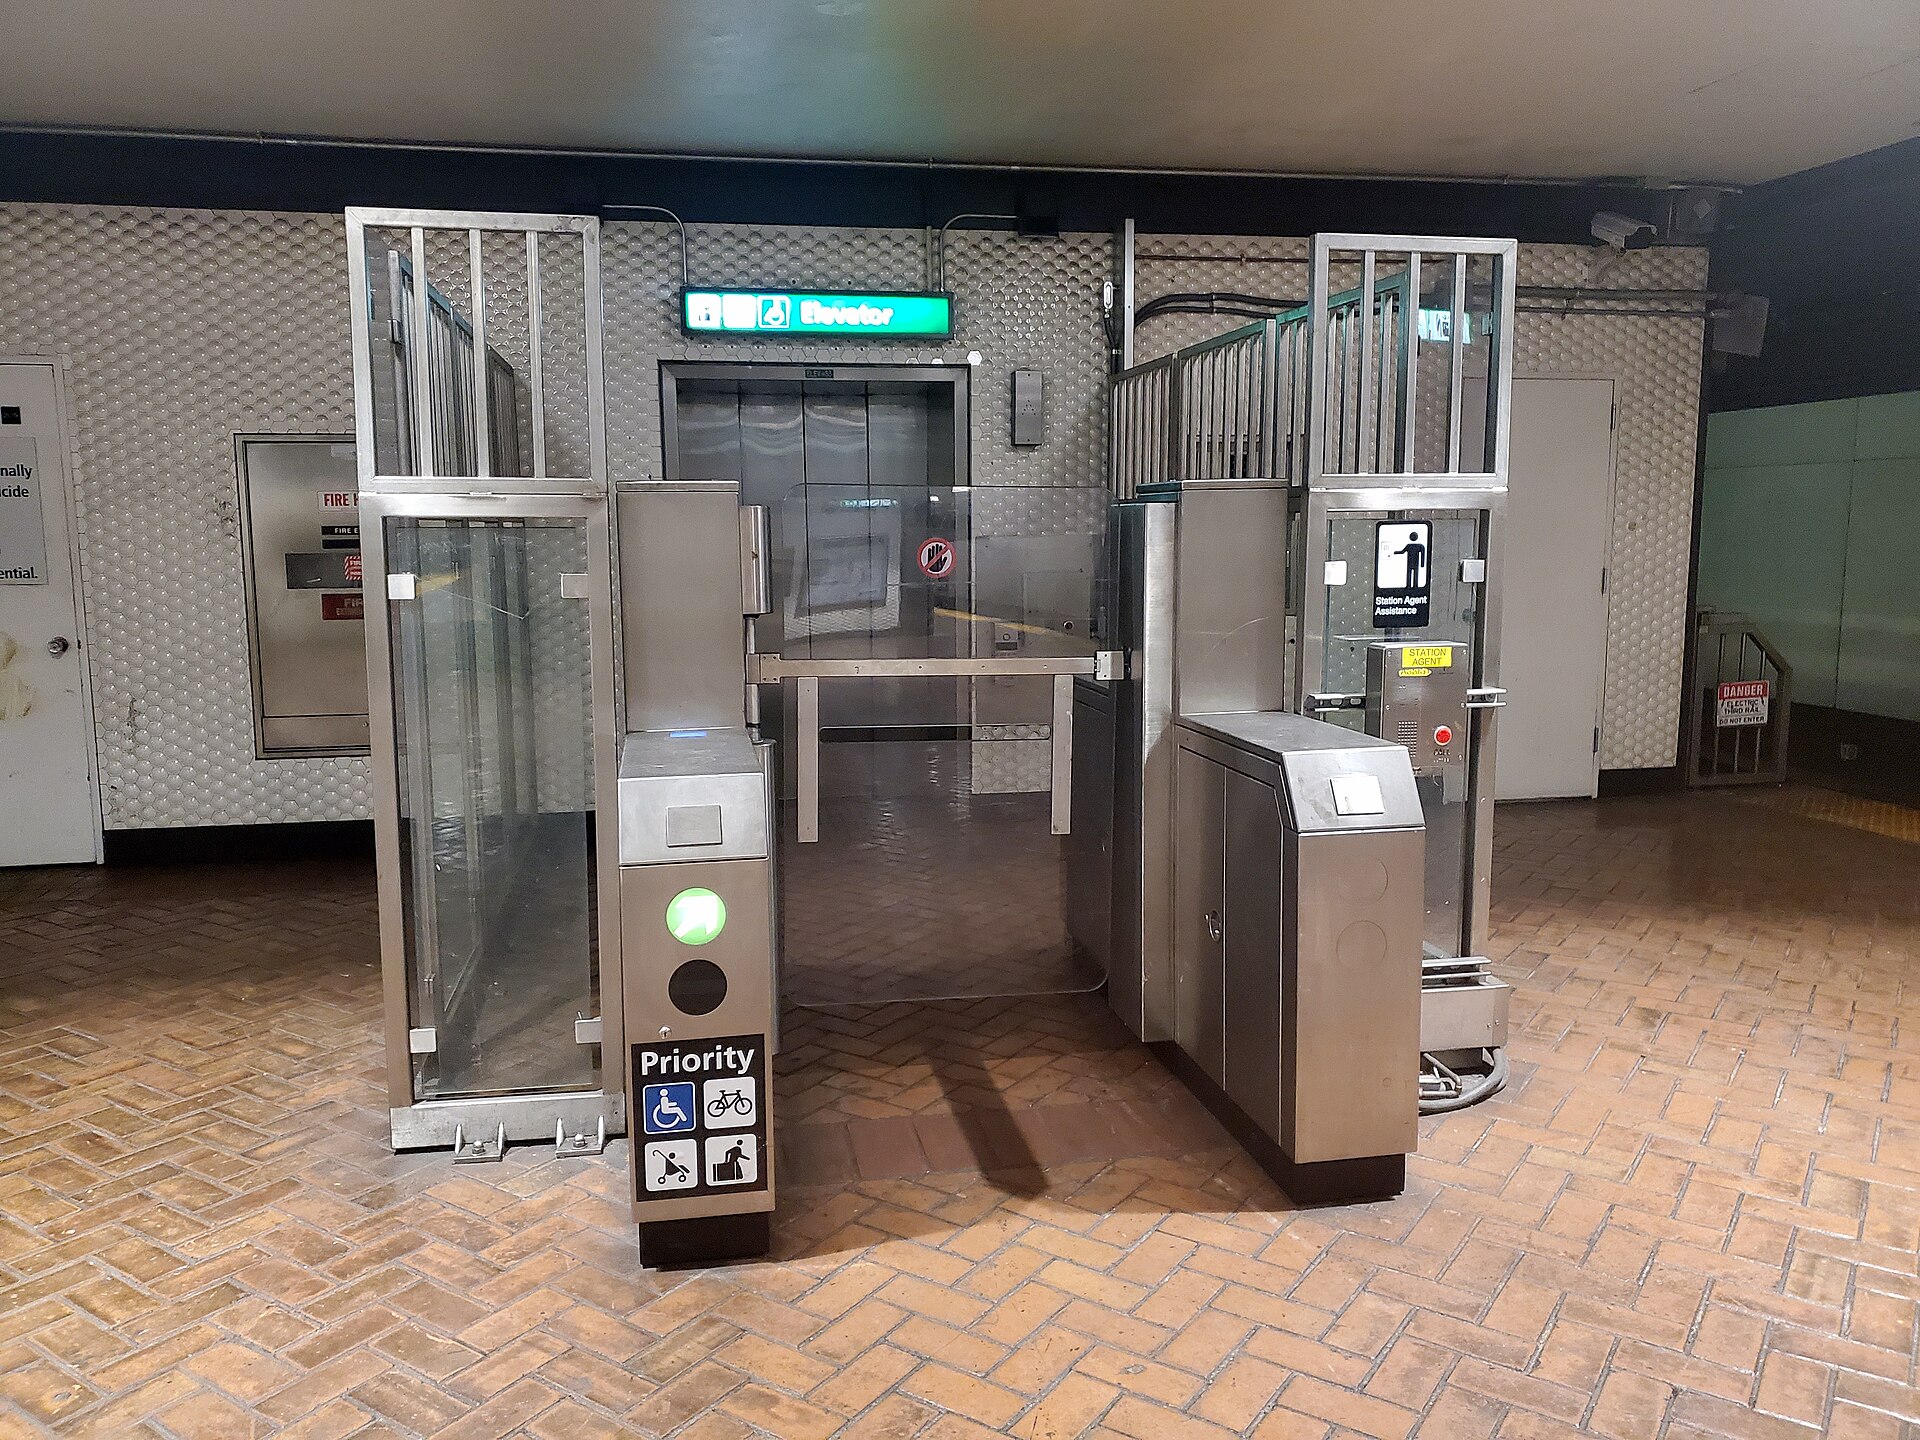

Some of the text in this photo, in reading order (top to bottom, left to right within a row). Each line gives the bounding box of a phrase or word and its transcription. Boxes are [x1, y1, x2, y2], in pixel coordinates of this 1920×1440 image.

[800, 299, 894, 326] Elevator
[324, 493, 350, 507] FIRE
[1375, 595, 1428, 606] Station Agent
[1375, 606, 1417, 616] Assistance
[1409, 648, 1447, 657] STATION
[1412, 657, 1443, 667] AGENT
[1723, 684, 1764, 698] DANGER
[641, 1045, 755, 1076] Priority
